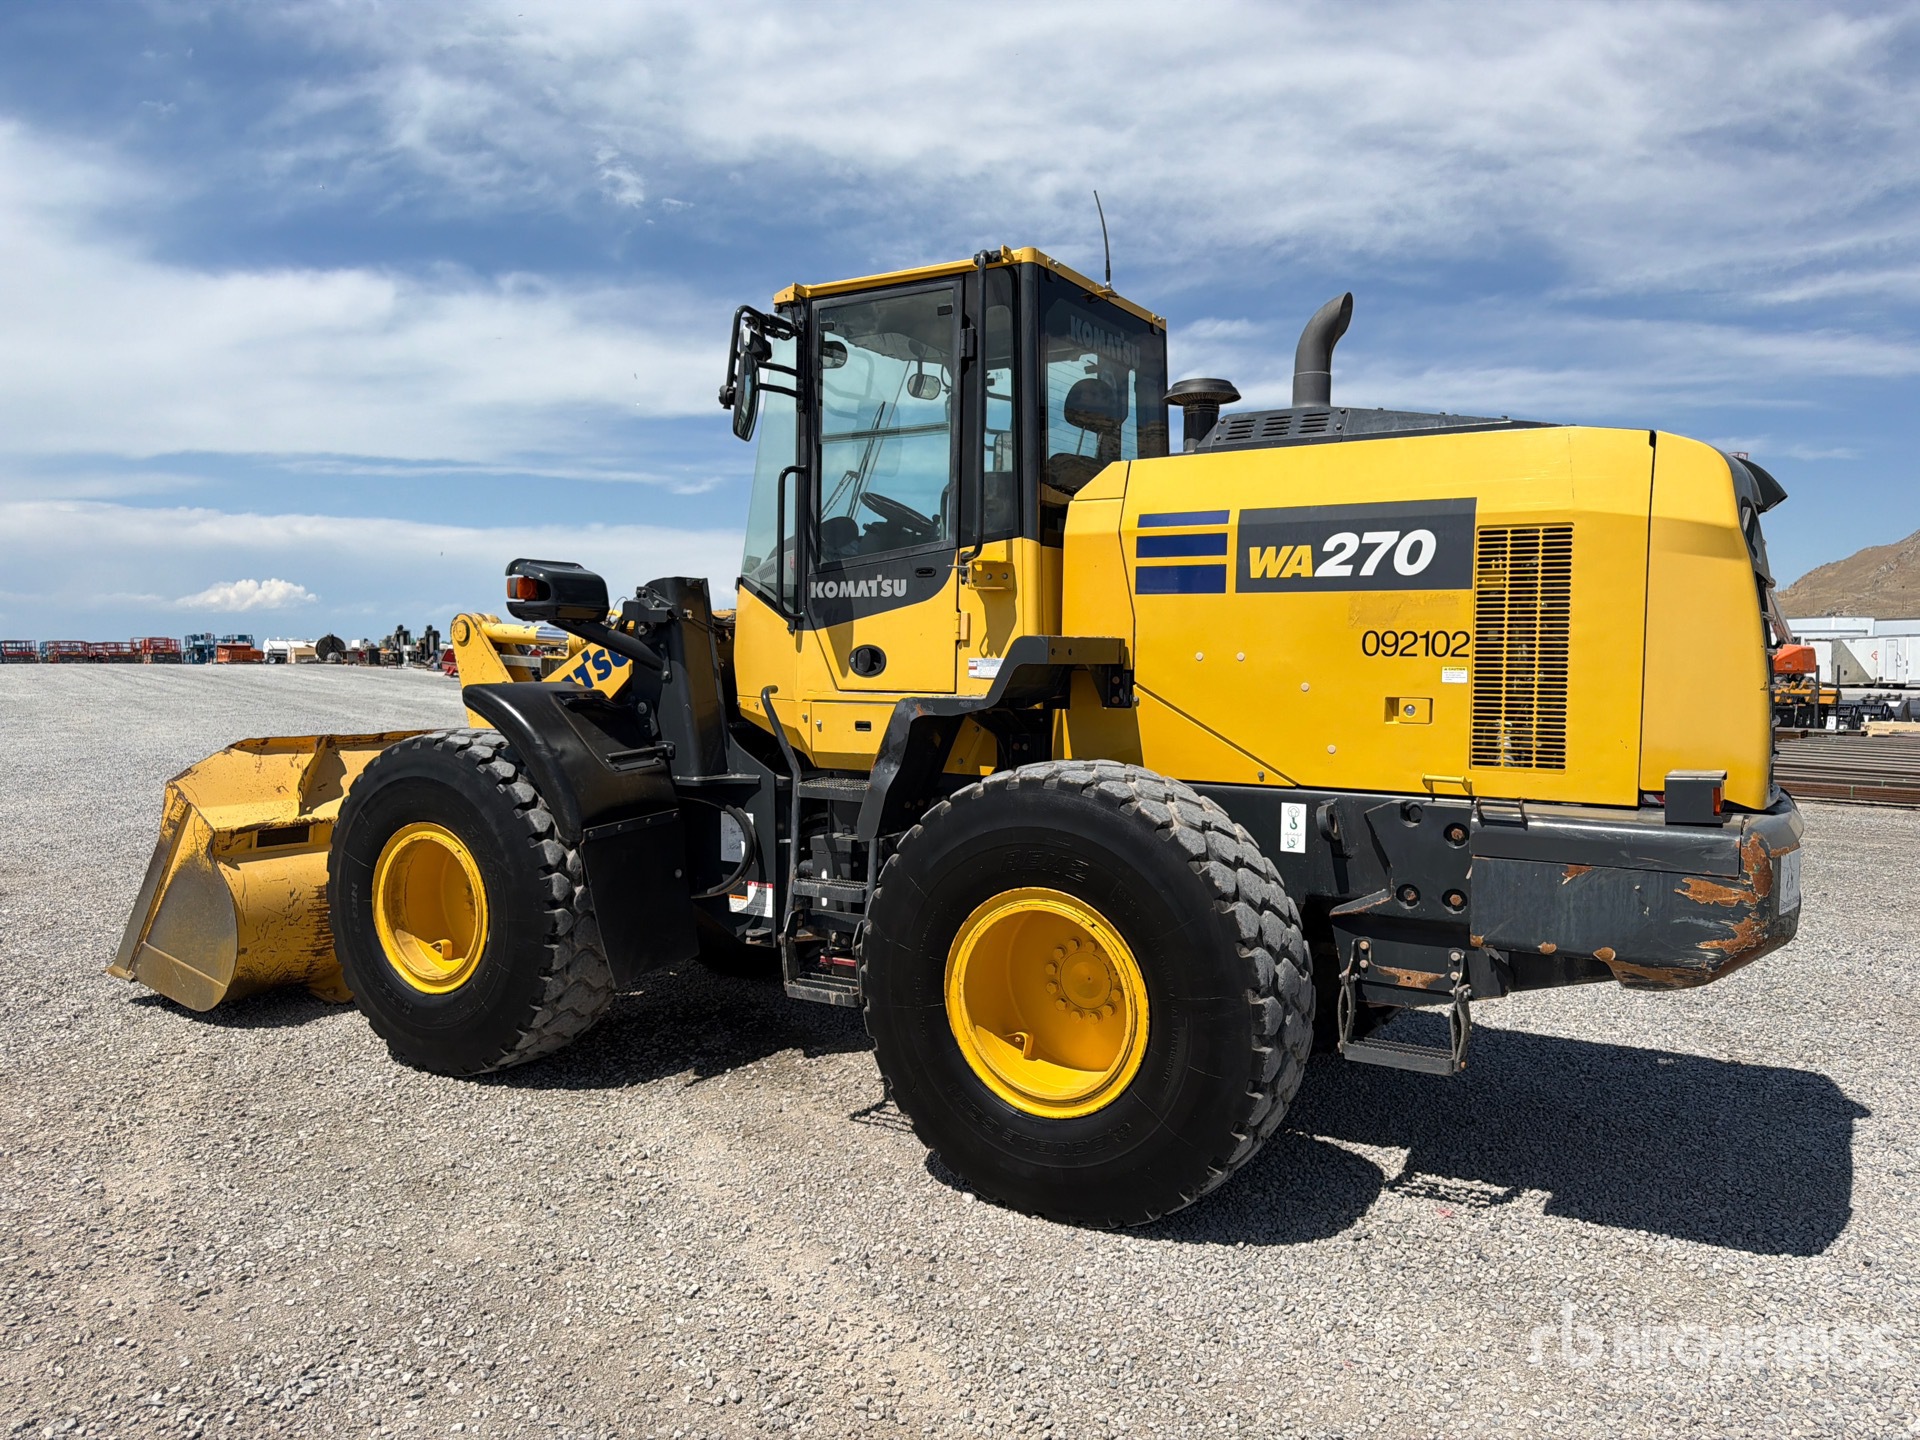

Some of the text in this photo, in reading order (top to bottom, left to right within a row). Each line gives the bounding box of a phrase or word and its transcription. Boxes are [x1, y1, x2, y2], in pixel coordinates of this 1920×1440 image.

[1070, 314, 1140, 369] KOMATSU
[1249, 529, 1437, 579] WA270
[810, 574, 907, 598] KOMATSU
[1361, 630, 1471, 657] 092102
